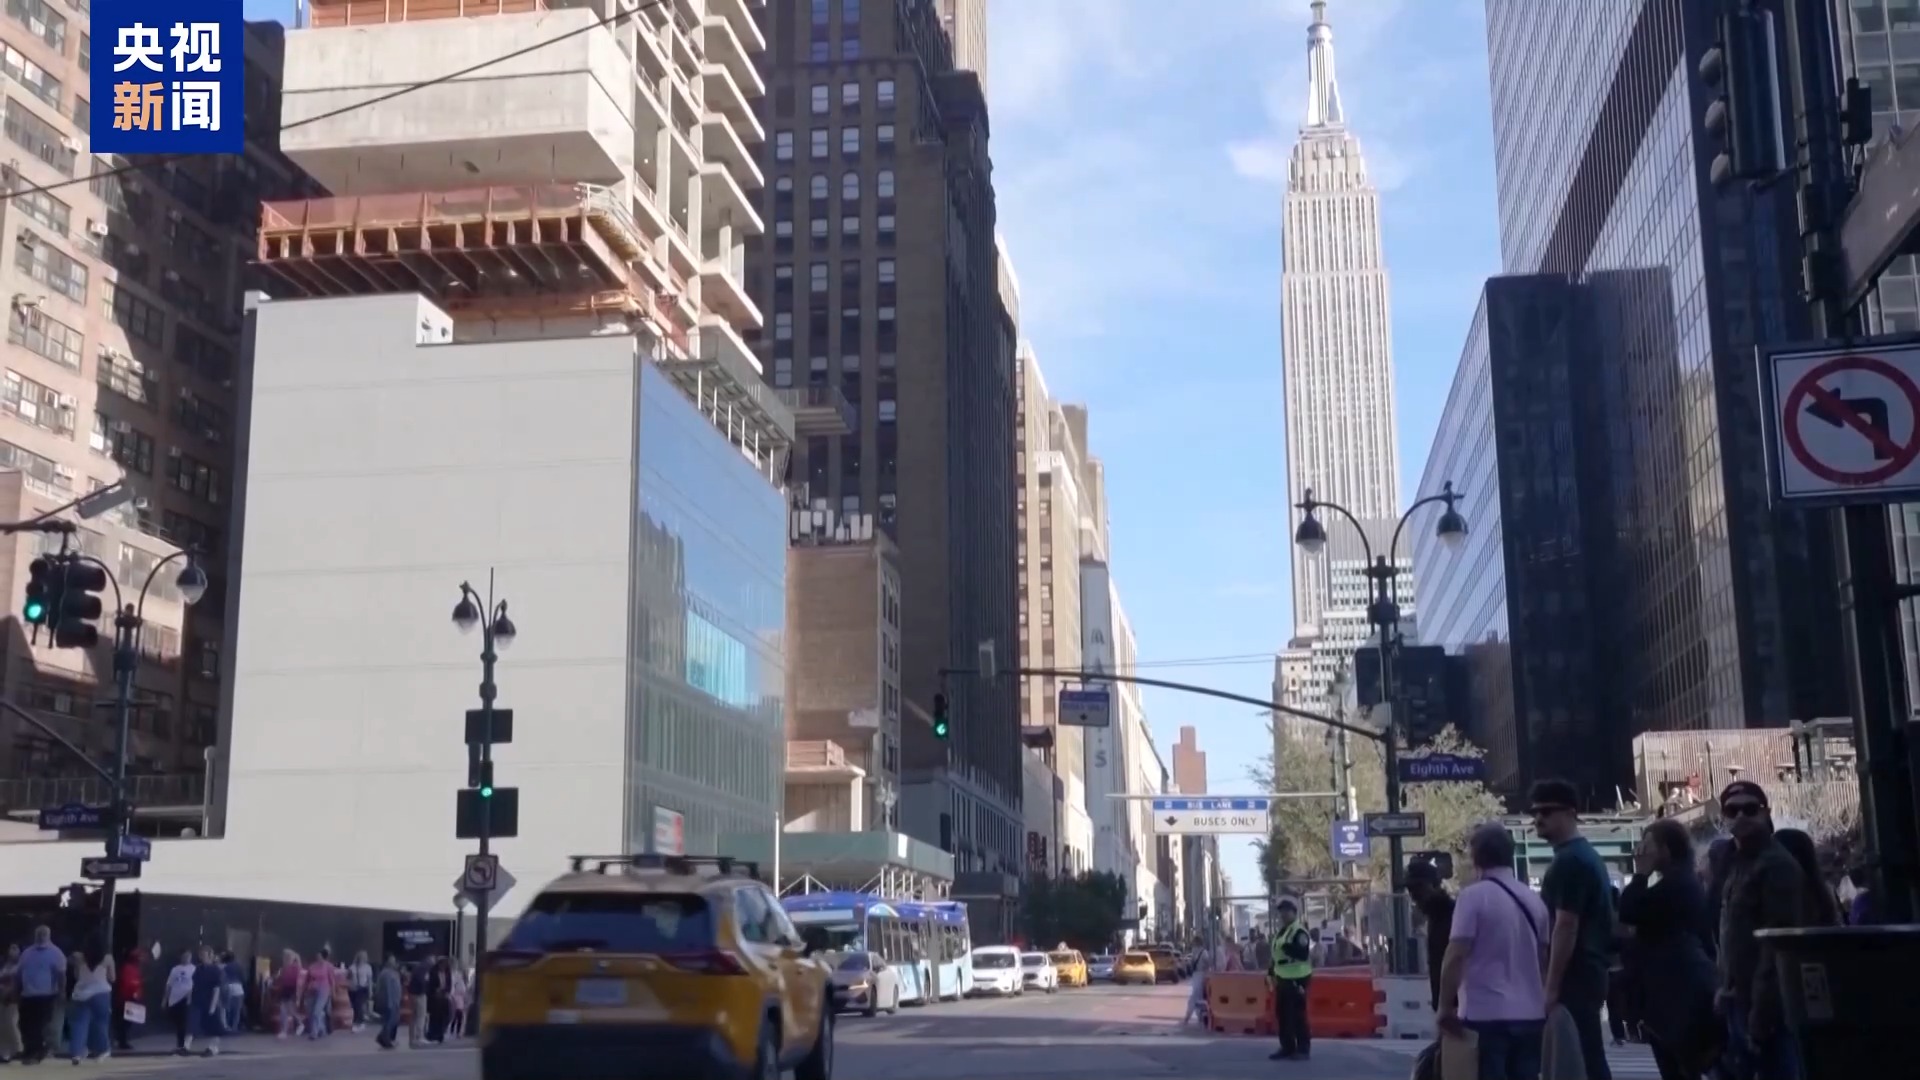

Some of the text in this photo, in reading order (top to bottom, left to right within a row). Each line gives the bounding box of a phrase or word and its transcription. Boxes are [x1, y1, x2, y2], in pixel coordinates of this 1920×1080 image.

[1410, 763, 1474, 777] Eighth Ave
[1187, 801, 1233, 809] BUS LANE
[1193, 817, 1257, 827] BUSES ONLY
